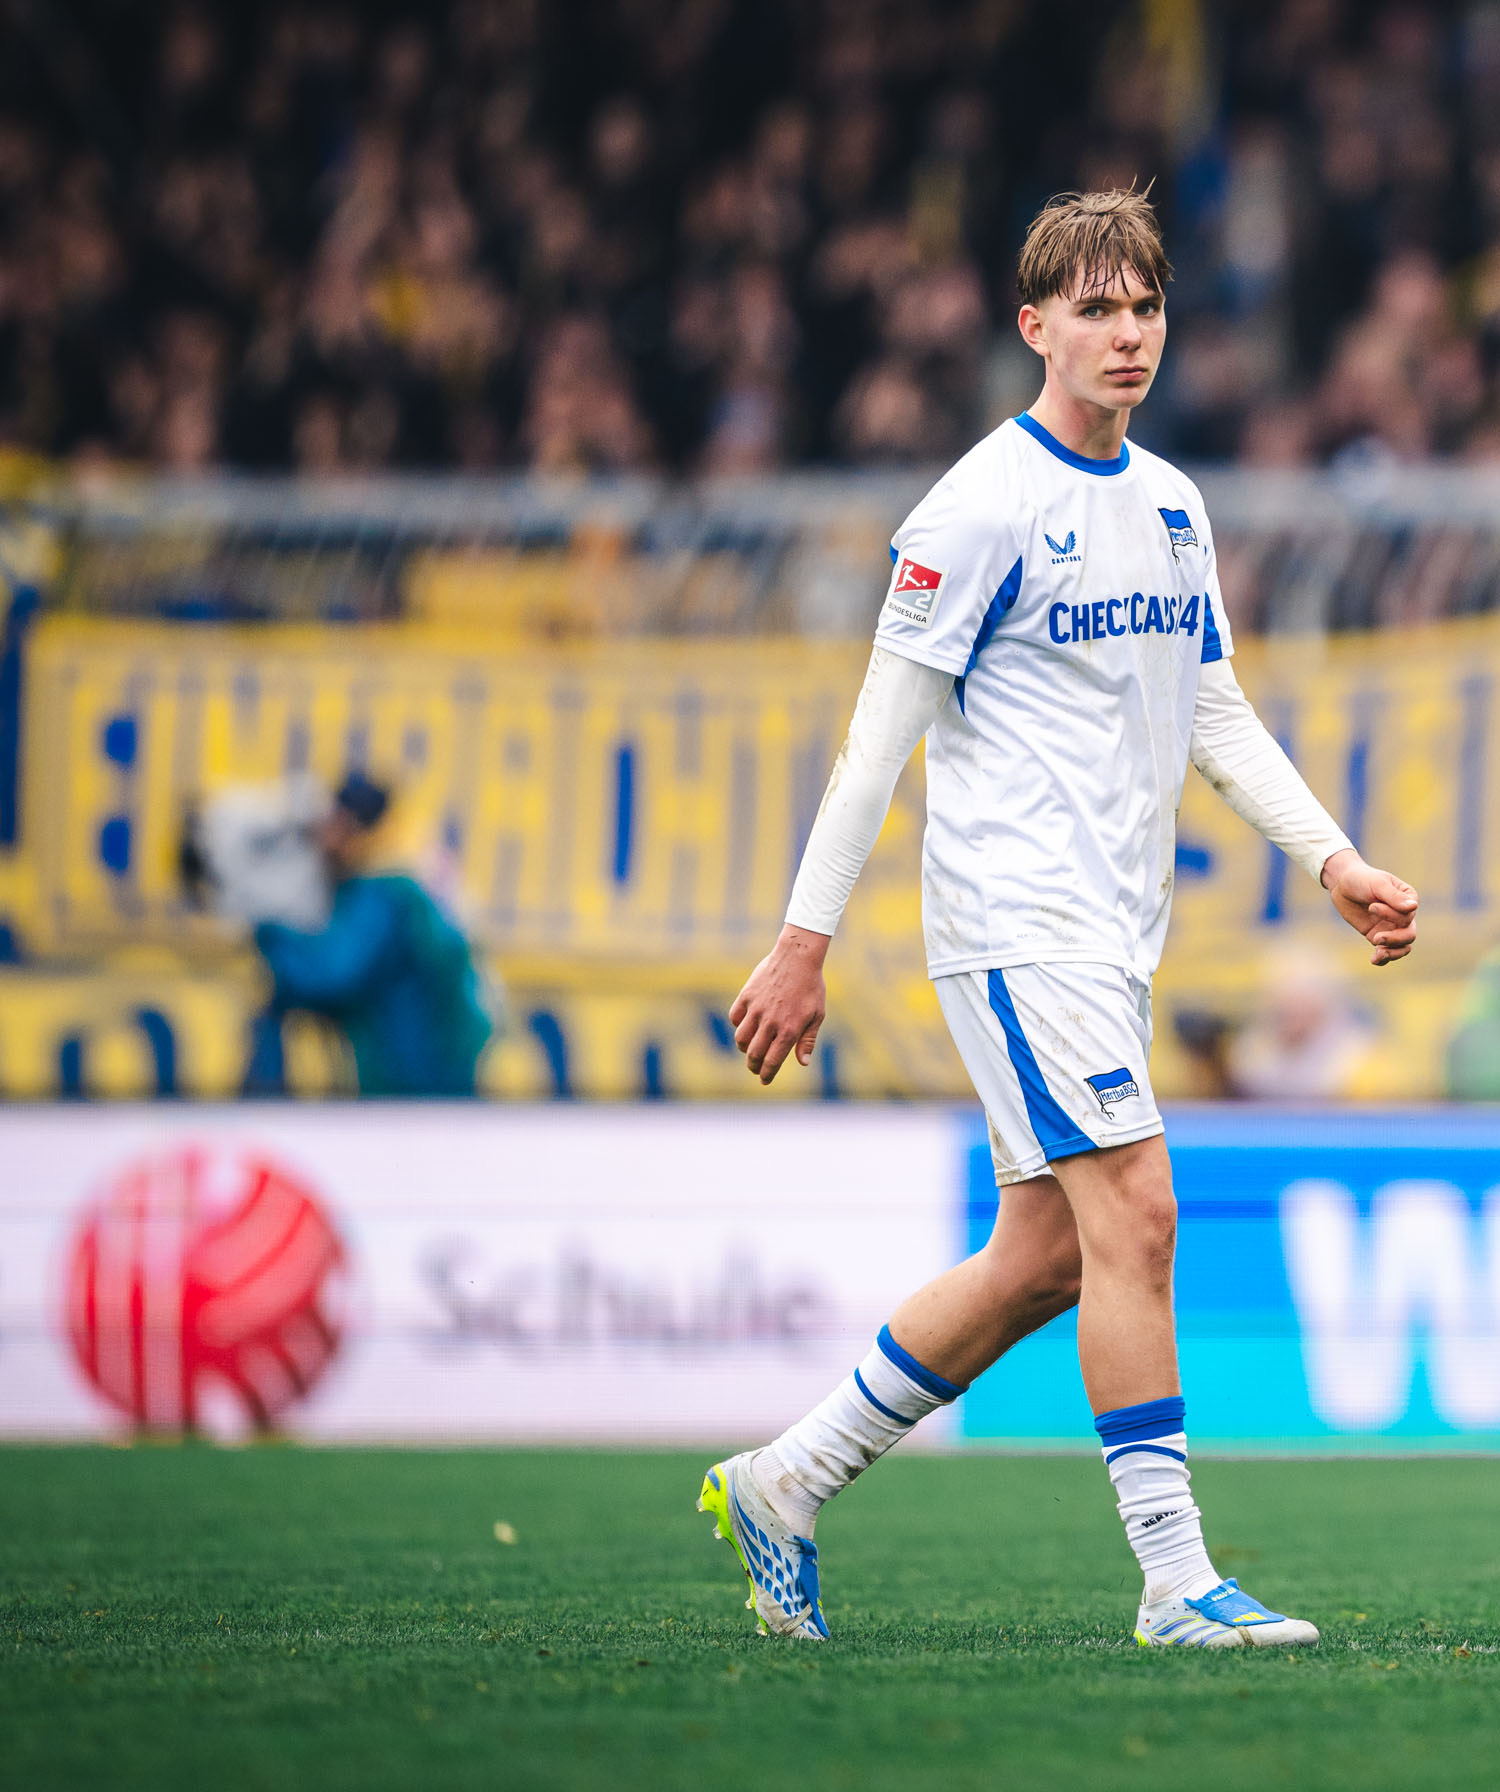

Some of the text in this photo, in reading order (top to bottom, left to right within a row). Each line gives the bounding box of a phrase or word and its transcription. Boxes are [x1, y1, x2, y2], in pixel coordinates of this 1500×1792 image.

[1051, 555, 1082, 565] CASTORE
[915, 590, 932, 610] 2
[887, 601, 928, 624] BUNDESLIGA
[414, 1230, 832, 1346] Schule
